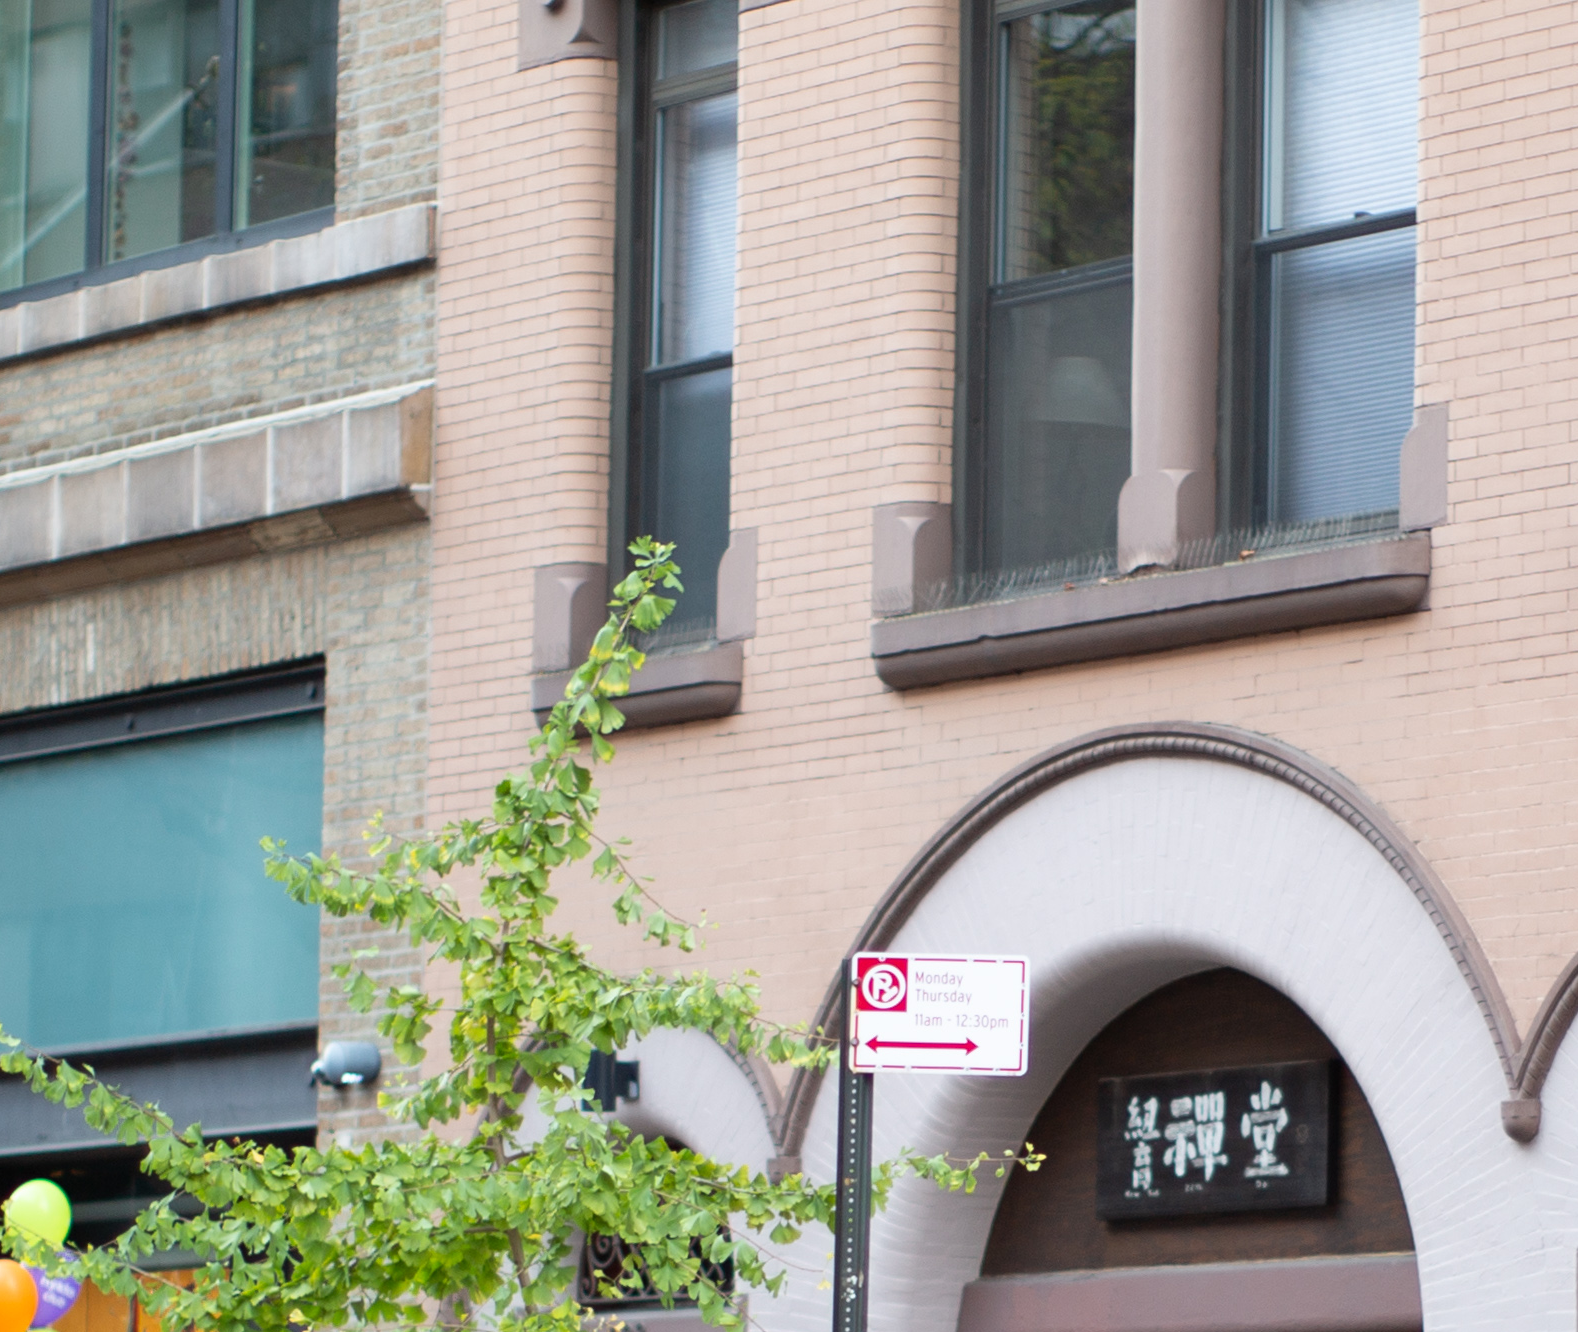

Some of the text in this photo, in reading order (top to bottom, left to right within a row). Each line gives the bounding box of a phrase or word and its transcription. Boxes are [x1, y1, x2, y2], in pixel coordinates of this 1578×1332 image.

[915, 971, 963, 988] Monday
[916, 989, 972, 1005] Thursday
[915, 1014, 943, 1027] 11am
[956, 1014, 1009, 1030] 12:30pm
